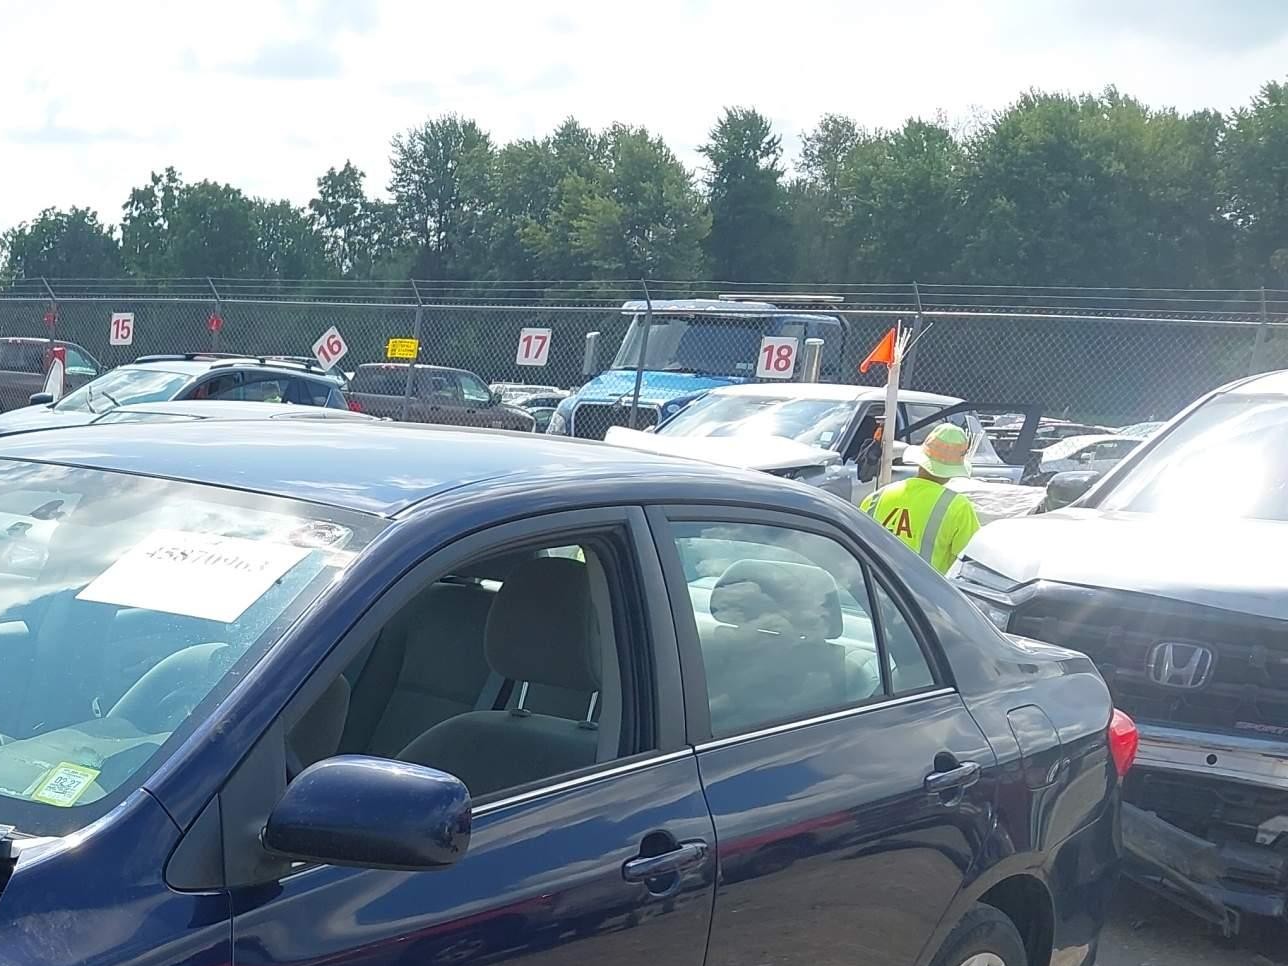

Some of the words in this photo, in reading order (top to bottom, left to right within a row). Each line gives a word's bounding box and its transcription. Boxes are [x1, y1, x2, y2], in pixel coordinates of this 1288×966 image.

[112, 319, 131, 340] 15
[317, 334, 342, 363] 16
[522, 335, 547, 360] 17
[762, 344, 793, 372] 18
